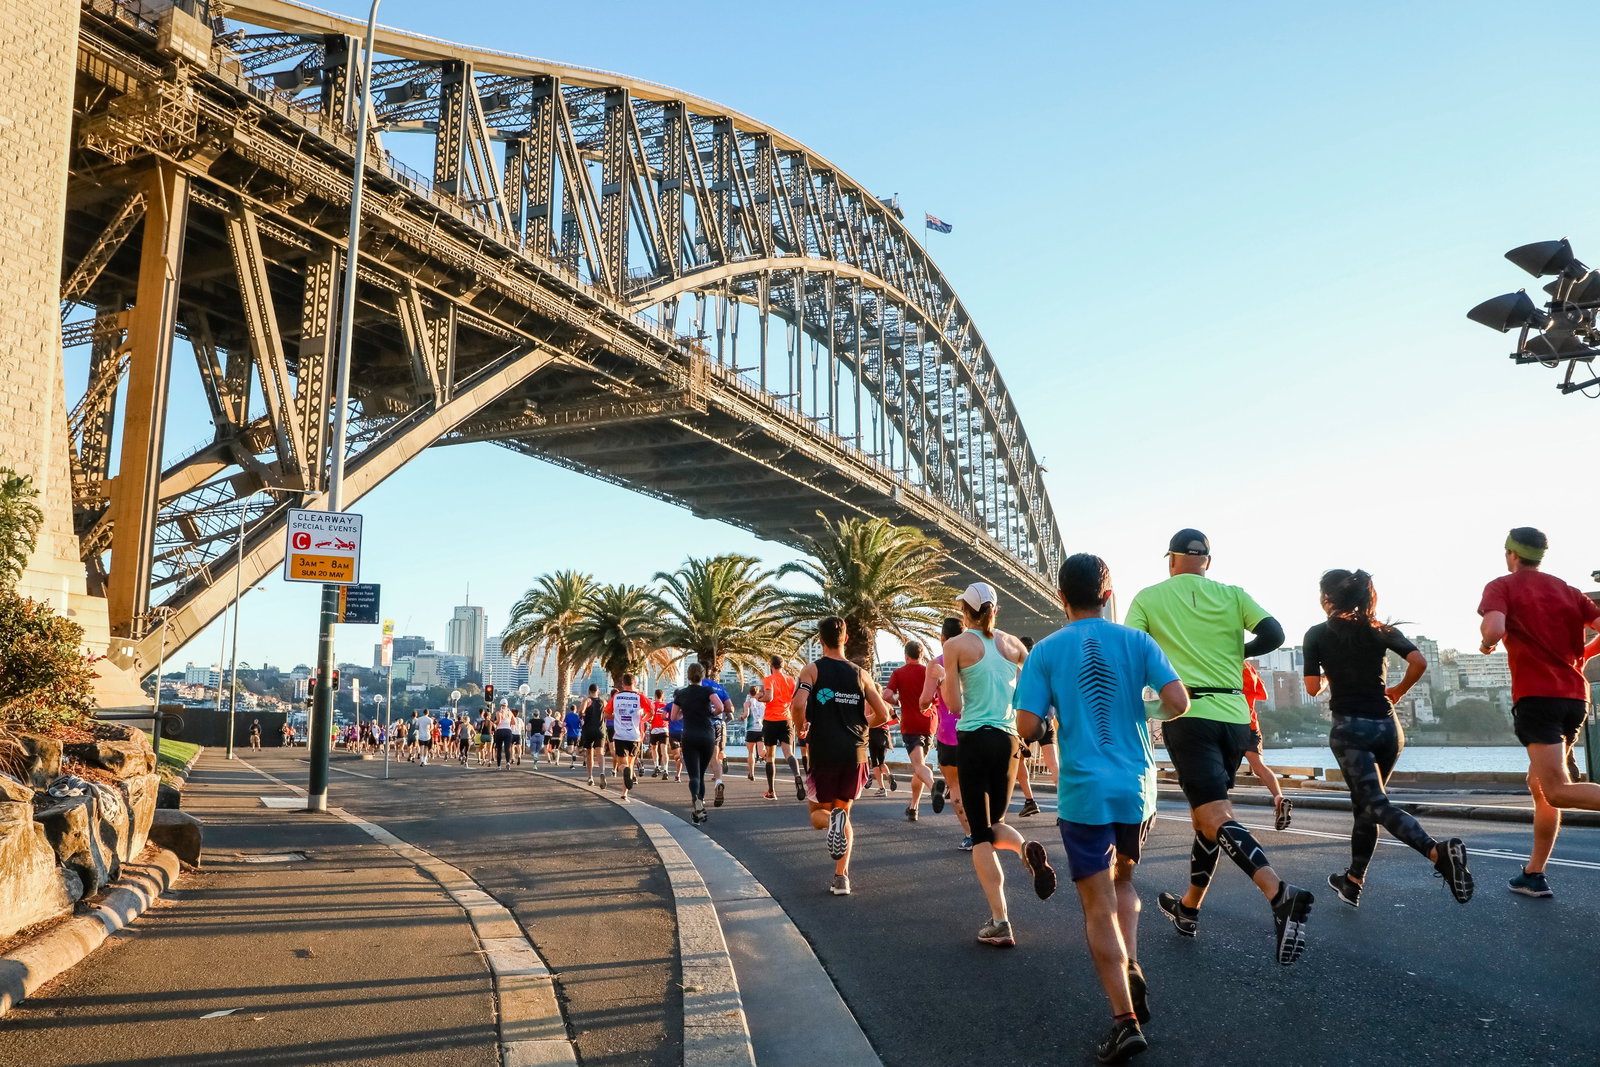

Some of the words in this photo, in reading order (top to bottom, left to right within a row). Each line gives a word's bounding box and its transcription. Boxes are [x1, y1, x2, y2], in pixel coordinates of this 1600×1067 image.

[297, 513, 354, 525] CLEARWAY
[292, 522, 325, 531] SPECIAL
[328, 525, 358, 533] EVENTS
[296, 533, 308, 549] C
[299, 557, 317, 567] 3AM
[331, 560, 350, 569] 8AM
[301, 569, 317, 577] SUN
[834, 691, 861, 700] dementia
[834, 697, 859, 705] australia
